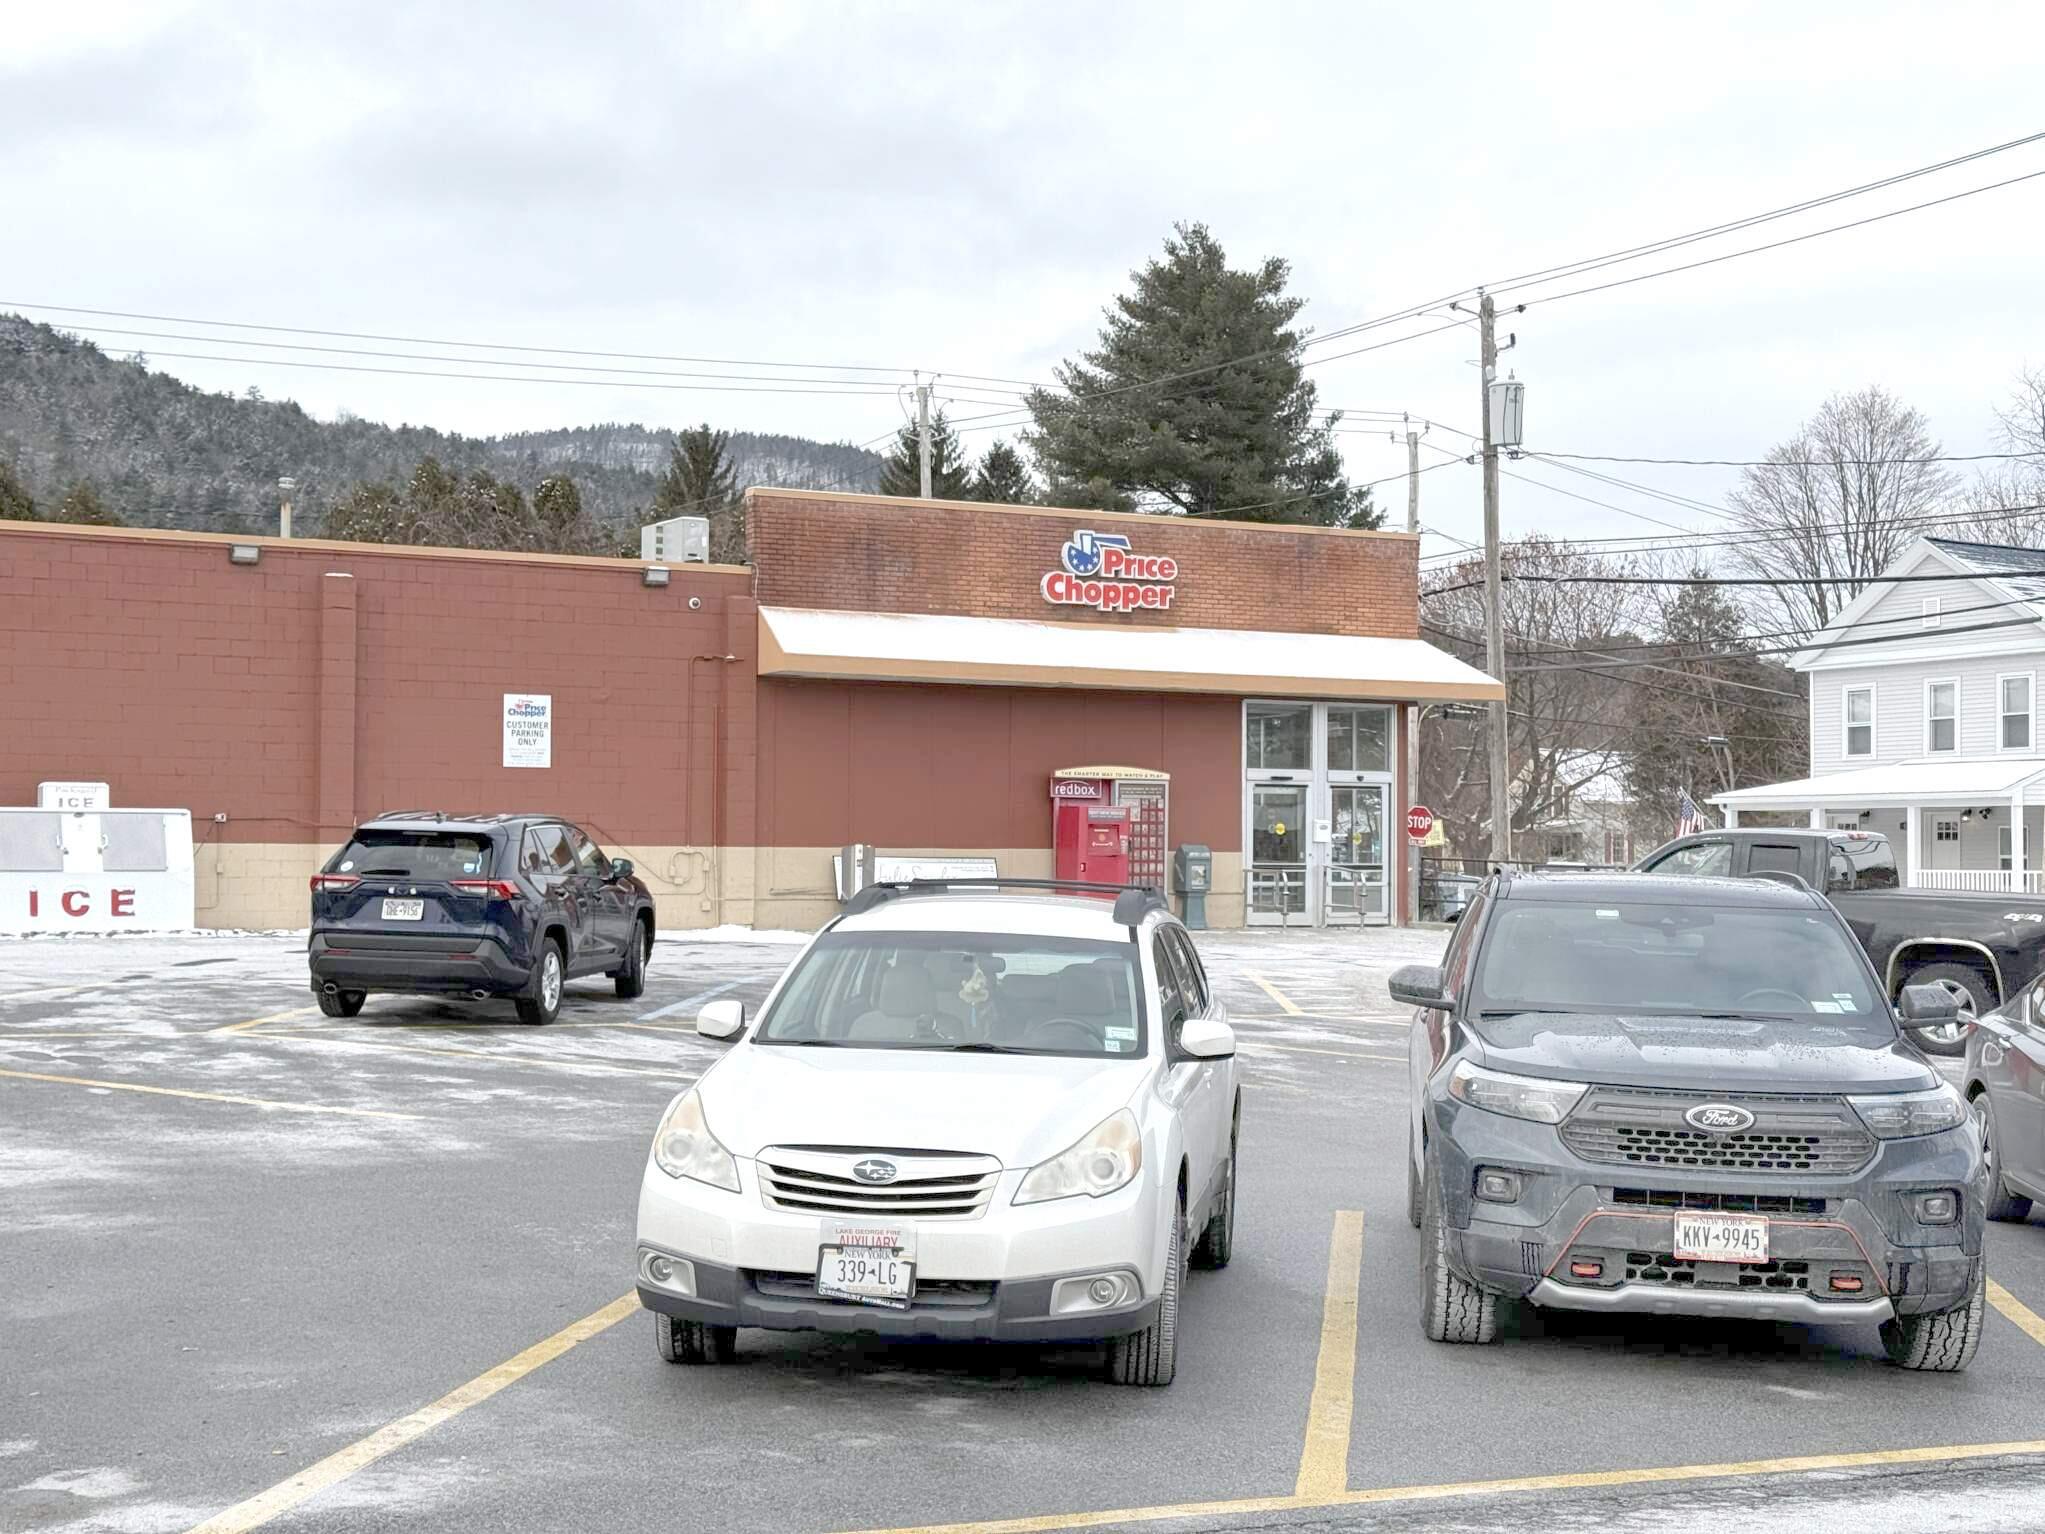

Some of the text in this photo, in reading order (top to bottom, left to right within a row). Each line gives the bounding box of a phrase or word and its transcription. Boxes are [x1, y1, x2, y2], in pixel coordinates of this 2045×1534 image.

[1104, 549, 1176, 578] Price
[1046, 573, 1173, 609] Chopper
[508, 708, 546, 718] Chopper
[524, 703, 547, 713] Price
[506, 720, 549, 729] CUSTOMER
[511, 729, 545, 738] PARKING
[517, 738, 538, 746] ONLY
[1055, 783, 1096, 795] redbox
[58, 797, 94, 808] ICE
[1408, 815, 1432, 829] STOP
[29, 888, 136, 917] ICE
[1702, 1109, 1739, 1126] Ford
[1699, 1216, 1744, 1227] NEW YORK
[855, 1228, 885, 1236] GEORGE
[839, 1235, 898, 1247] AUXILIARY
[844, 1248, 891, 1260] NEW YORK
